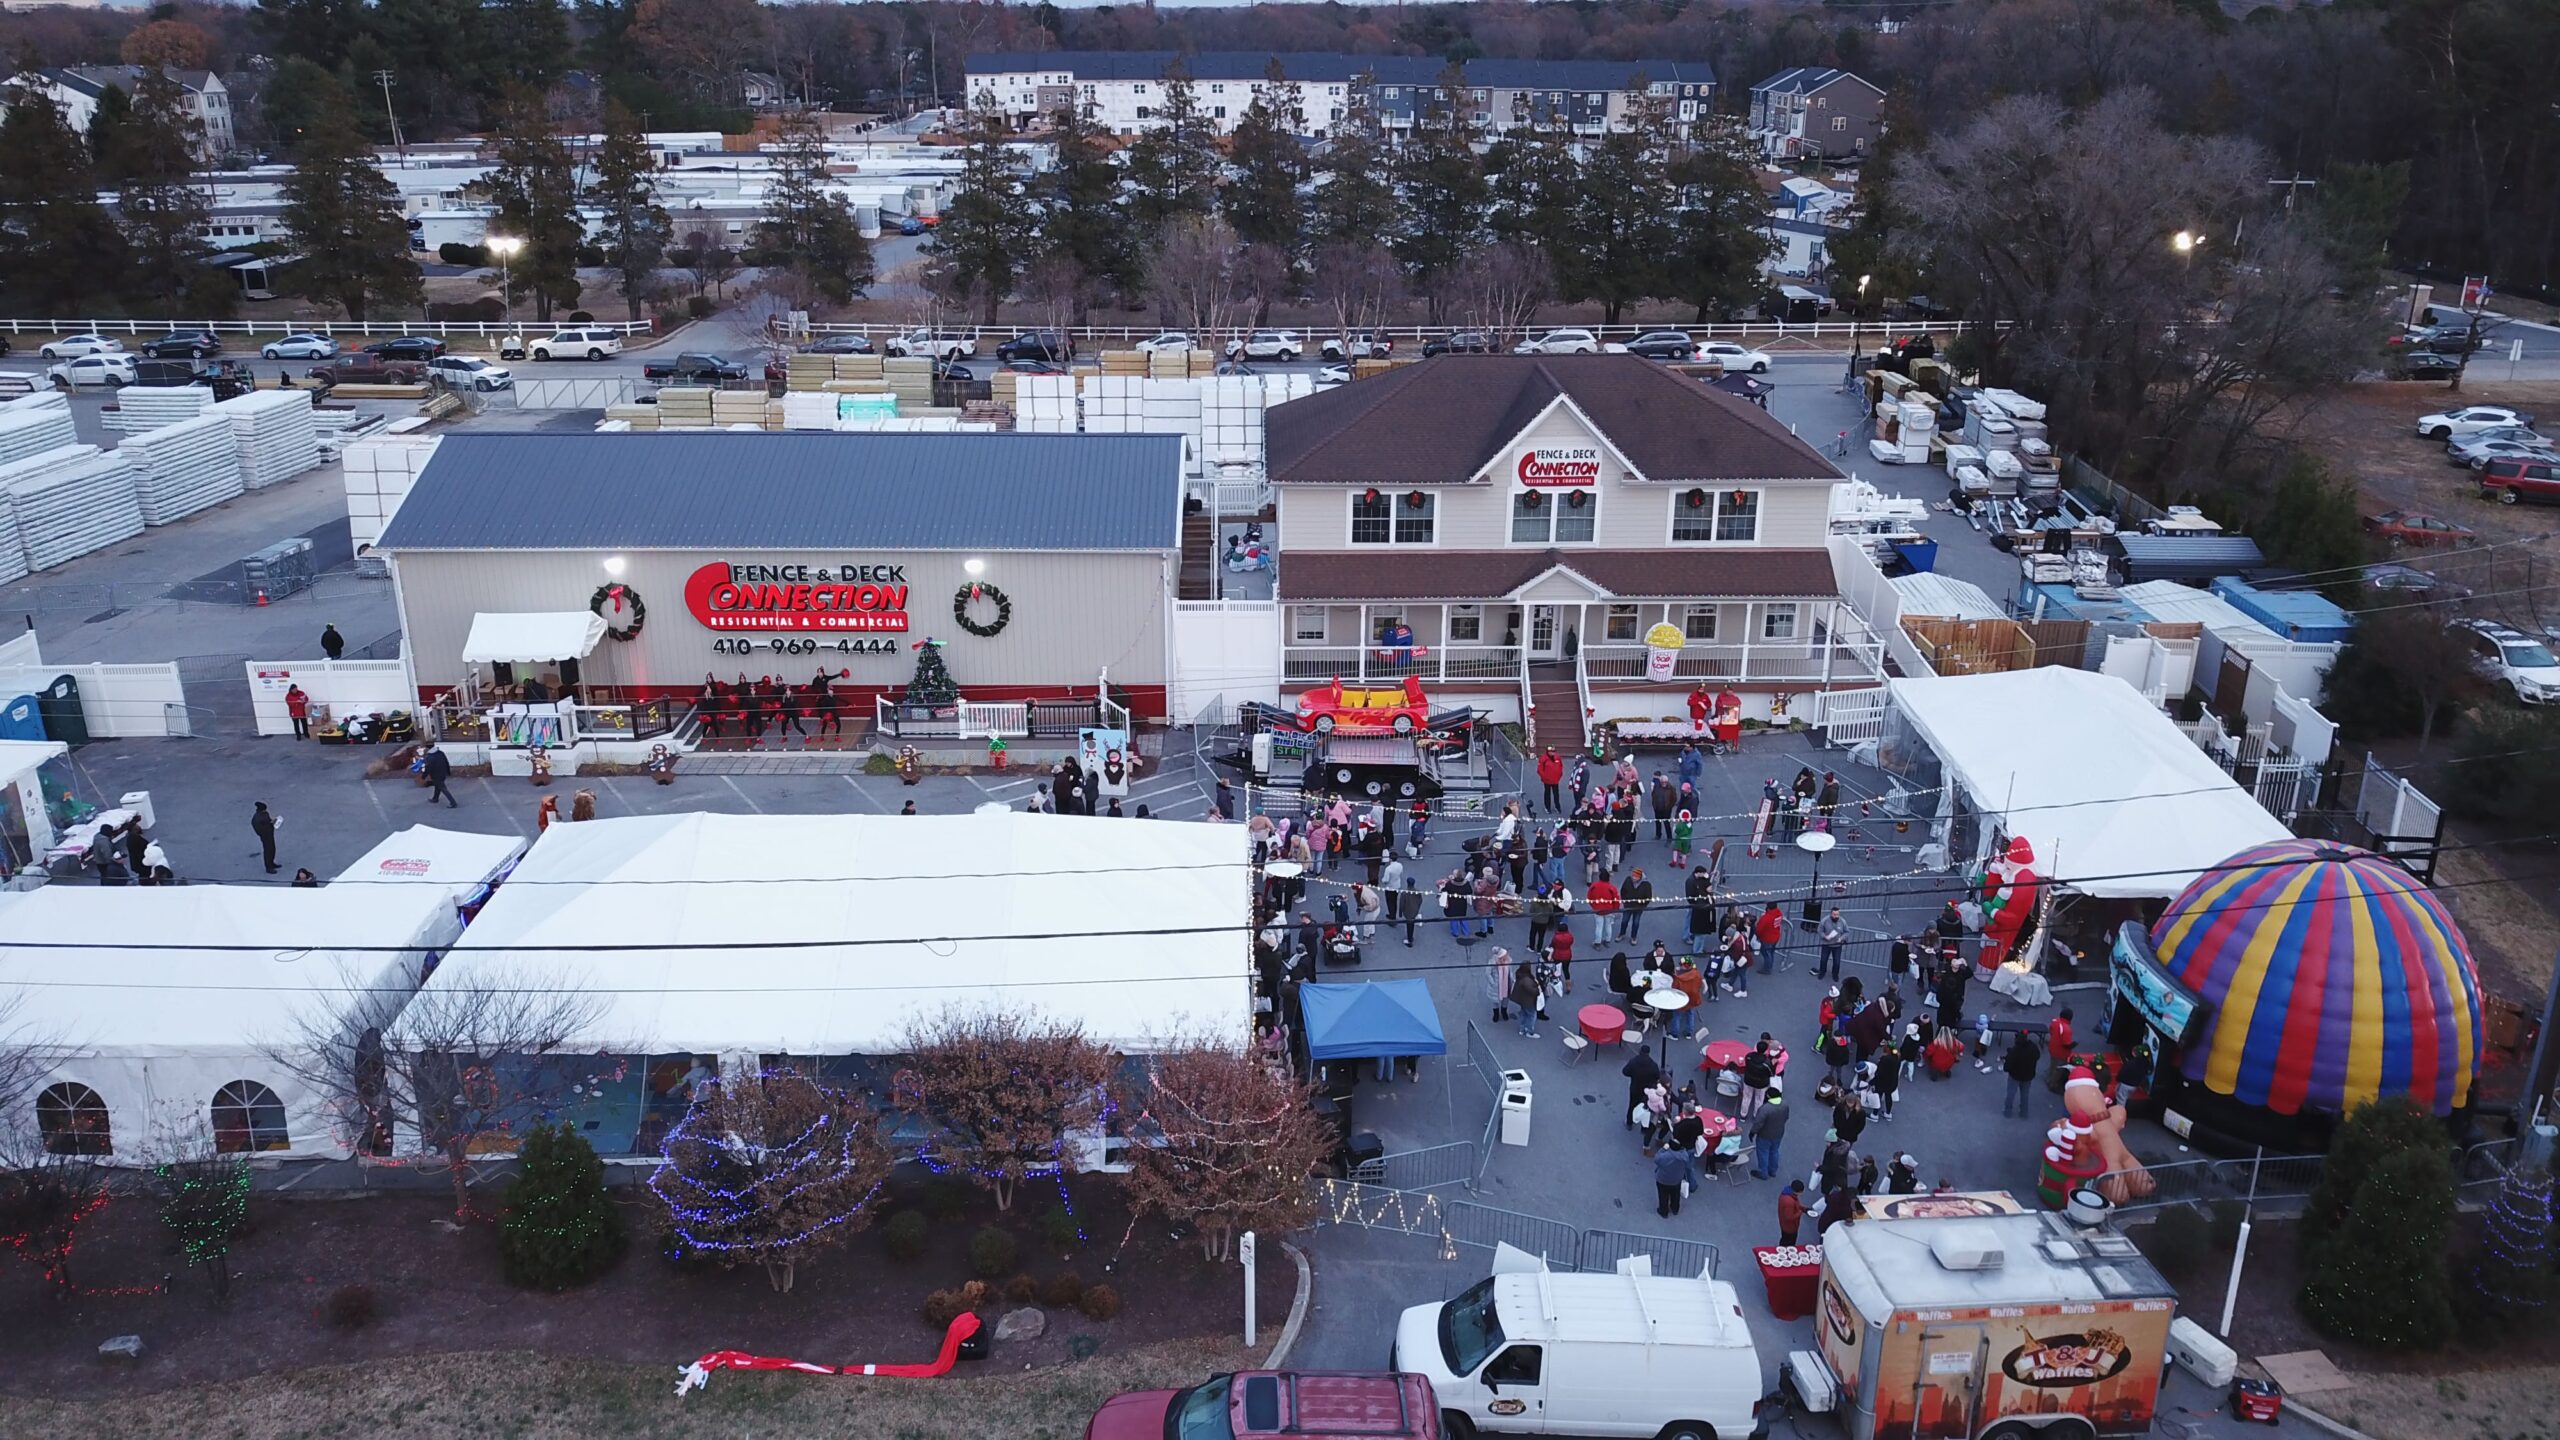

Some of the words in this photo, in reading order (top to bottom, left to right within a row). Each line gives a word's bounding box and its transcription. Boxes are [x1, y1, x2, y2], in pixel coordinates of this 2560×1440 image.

[1537, 450, 1563, 459] FENCE
[1573, 450, 1596, 459] DECK
[1518, 451, 1600, 476] CONNECTION
[733, 565, 809, 582] FENCE
[817, 568, 833, 581] &
[840, 564, 907, 582] DECK
[684, 562, 908, 612] CONNECTION
[711, 616, 794, 626] RESIDENTIAL
[802, 616, 810, 626] &
[820, 617, 904, 627] COMMERCIAL
[713, 638, 898, 655] 410-969-4444
[2056, 1345, 2074, 1361] &
